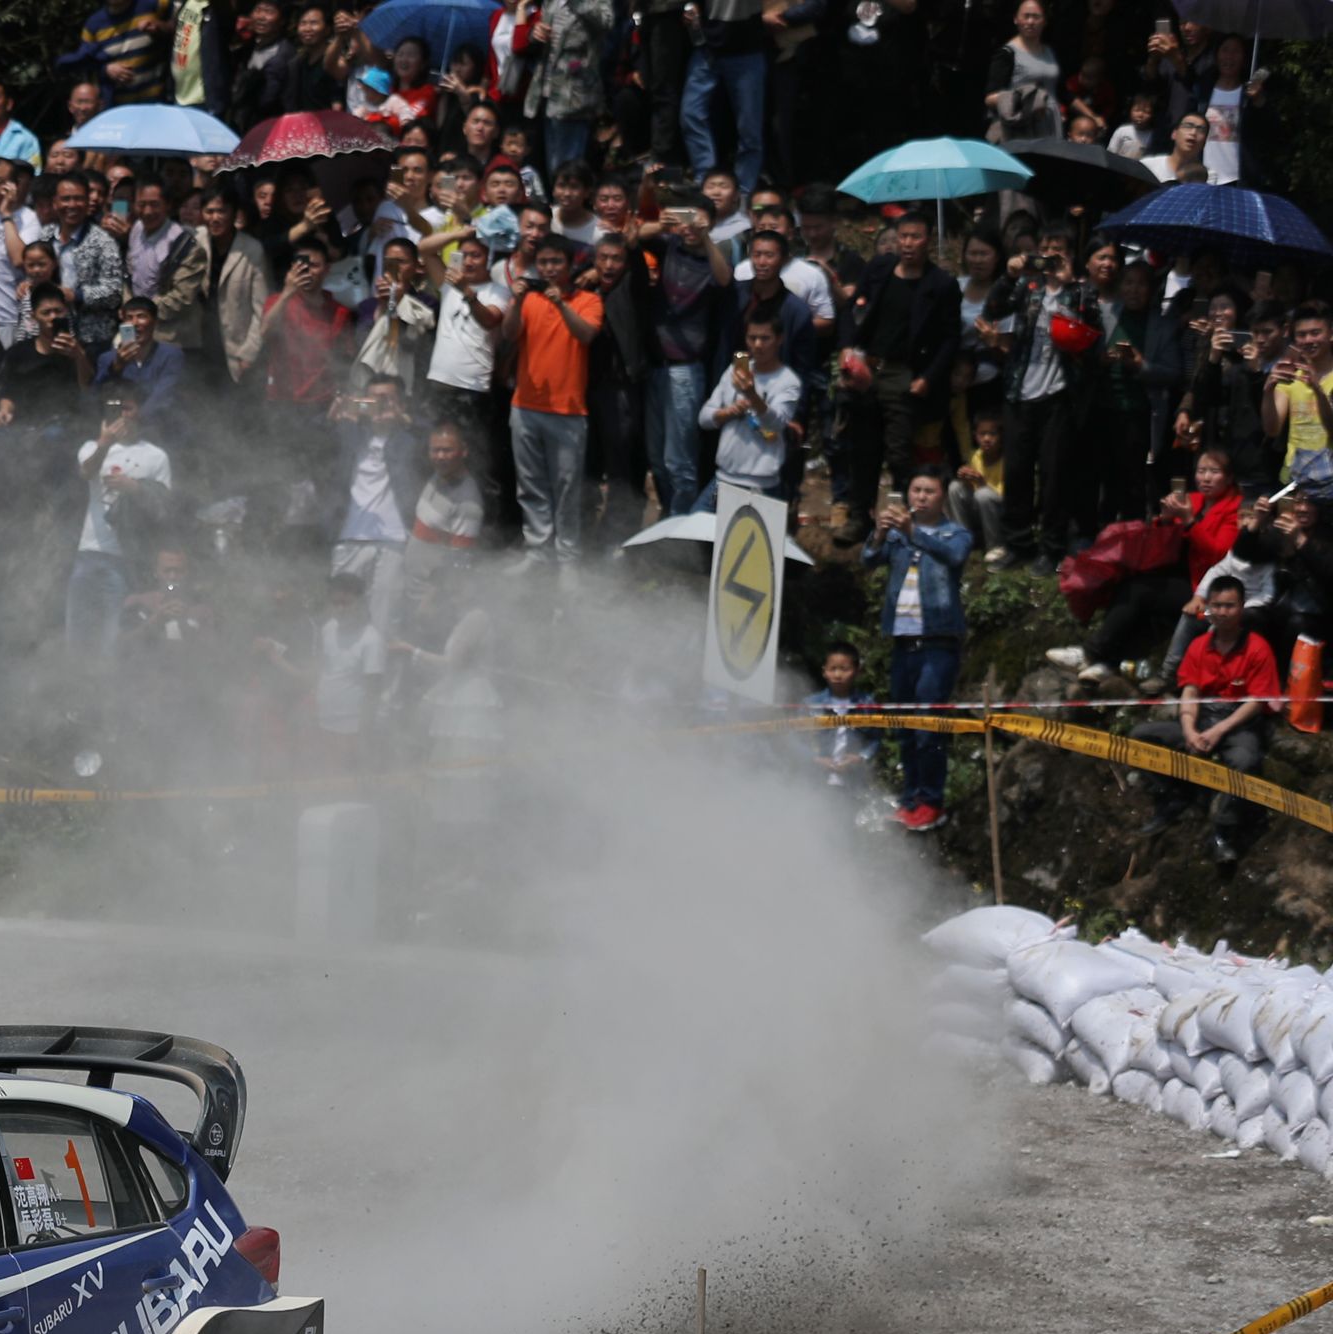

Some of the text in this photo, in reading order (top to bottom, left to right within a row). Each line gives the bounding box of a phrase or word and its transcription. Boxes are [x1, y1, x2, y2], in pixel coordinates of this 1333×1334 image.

[49, 1187, 63, 1202] A+
[64, 1139, 96, 1228] 1
[54, 1211, 67, 1227] B+
[71, 1261, 104, 1309] XV
